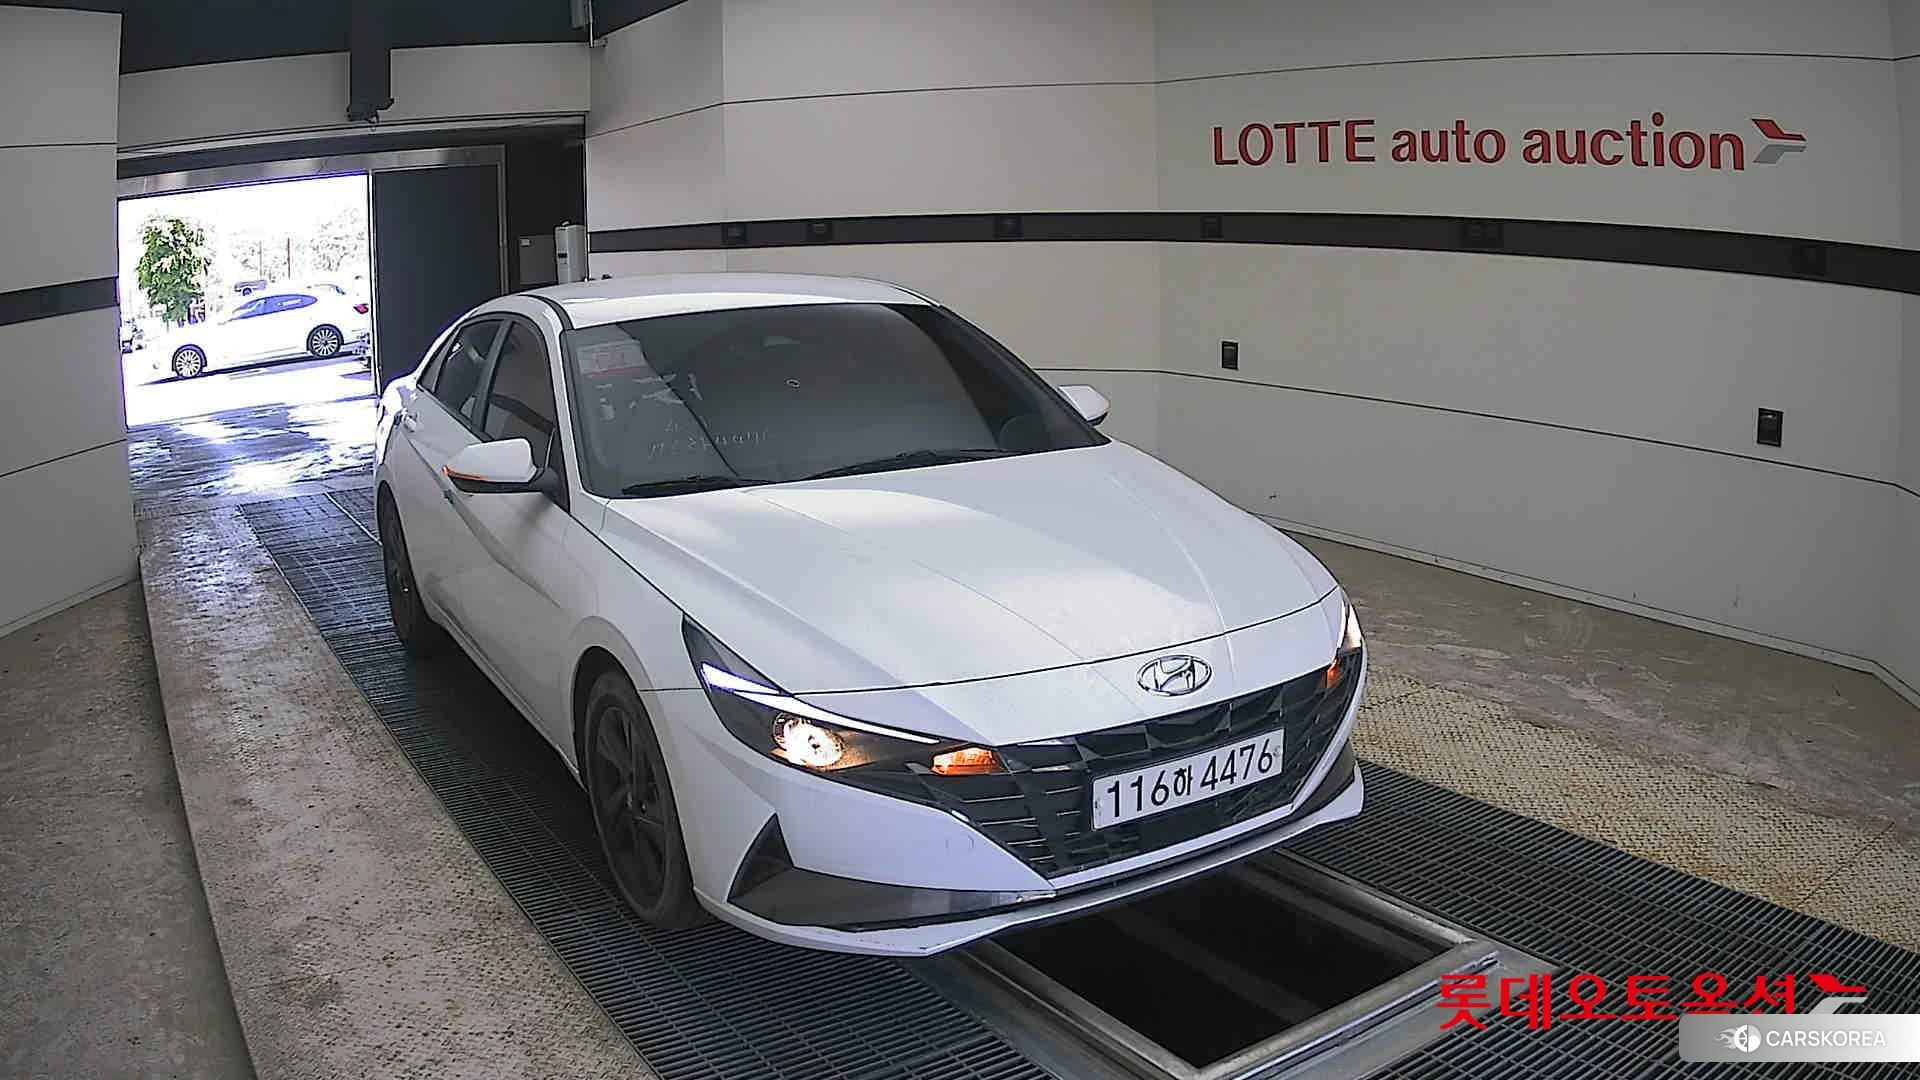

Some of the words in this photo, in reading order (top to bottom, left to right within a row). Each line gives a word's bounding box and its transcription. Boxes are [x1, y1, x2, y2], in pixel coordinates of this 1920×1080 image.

[1213, 119, 1376, 166] LOTTE
[1391, 119, 1507, 165] auto
[1522, 112, 1745, 171] auction
[1107, 764, 1193, 818] 116하
[1200, 738, 1274, 791] 4476
